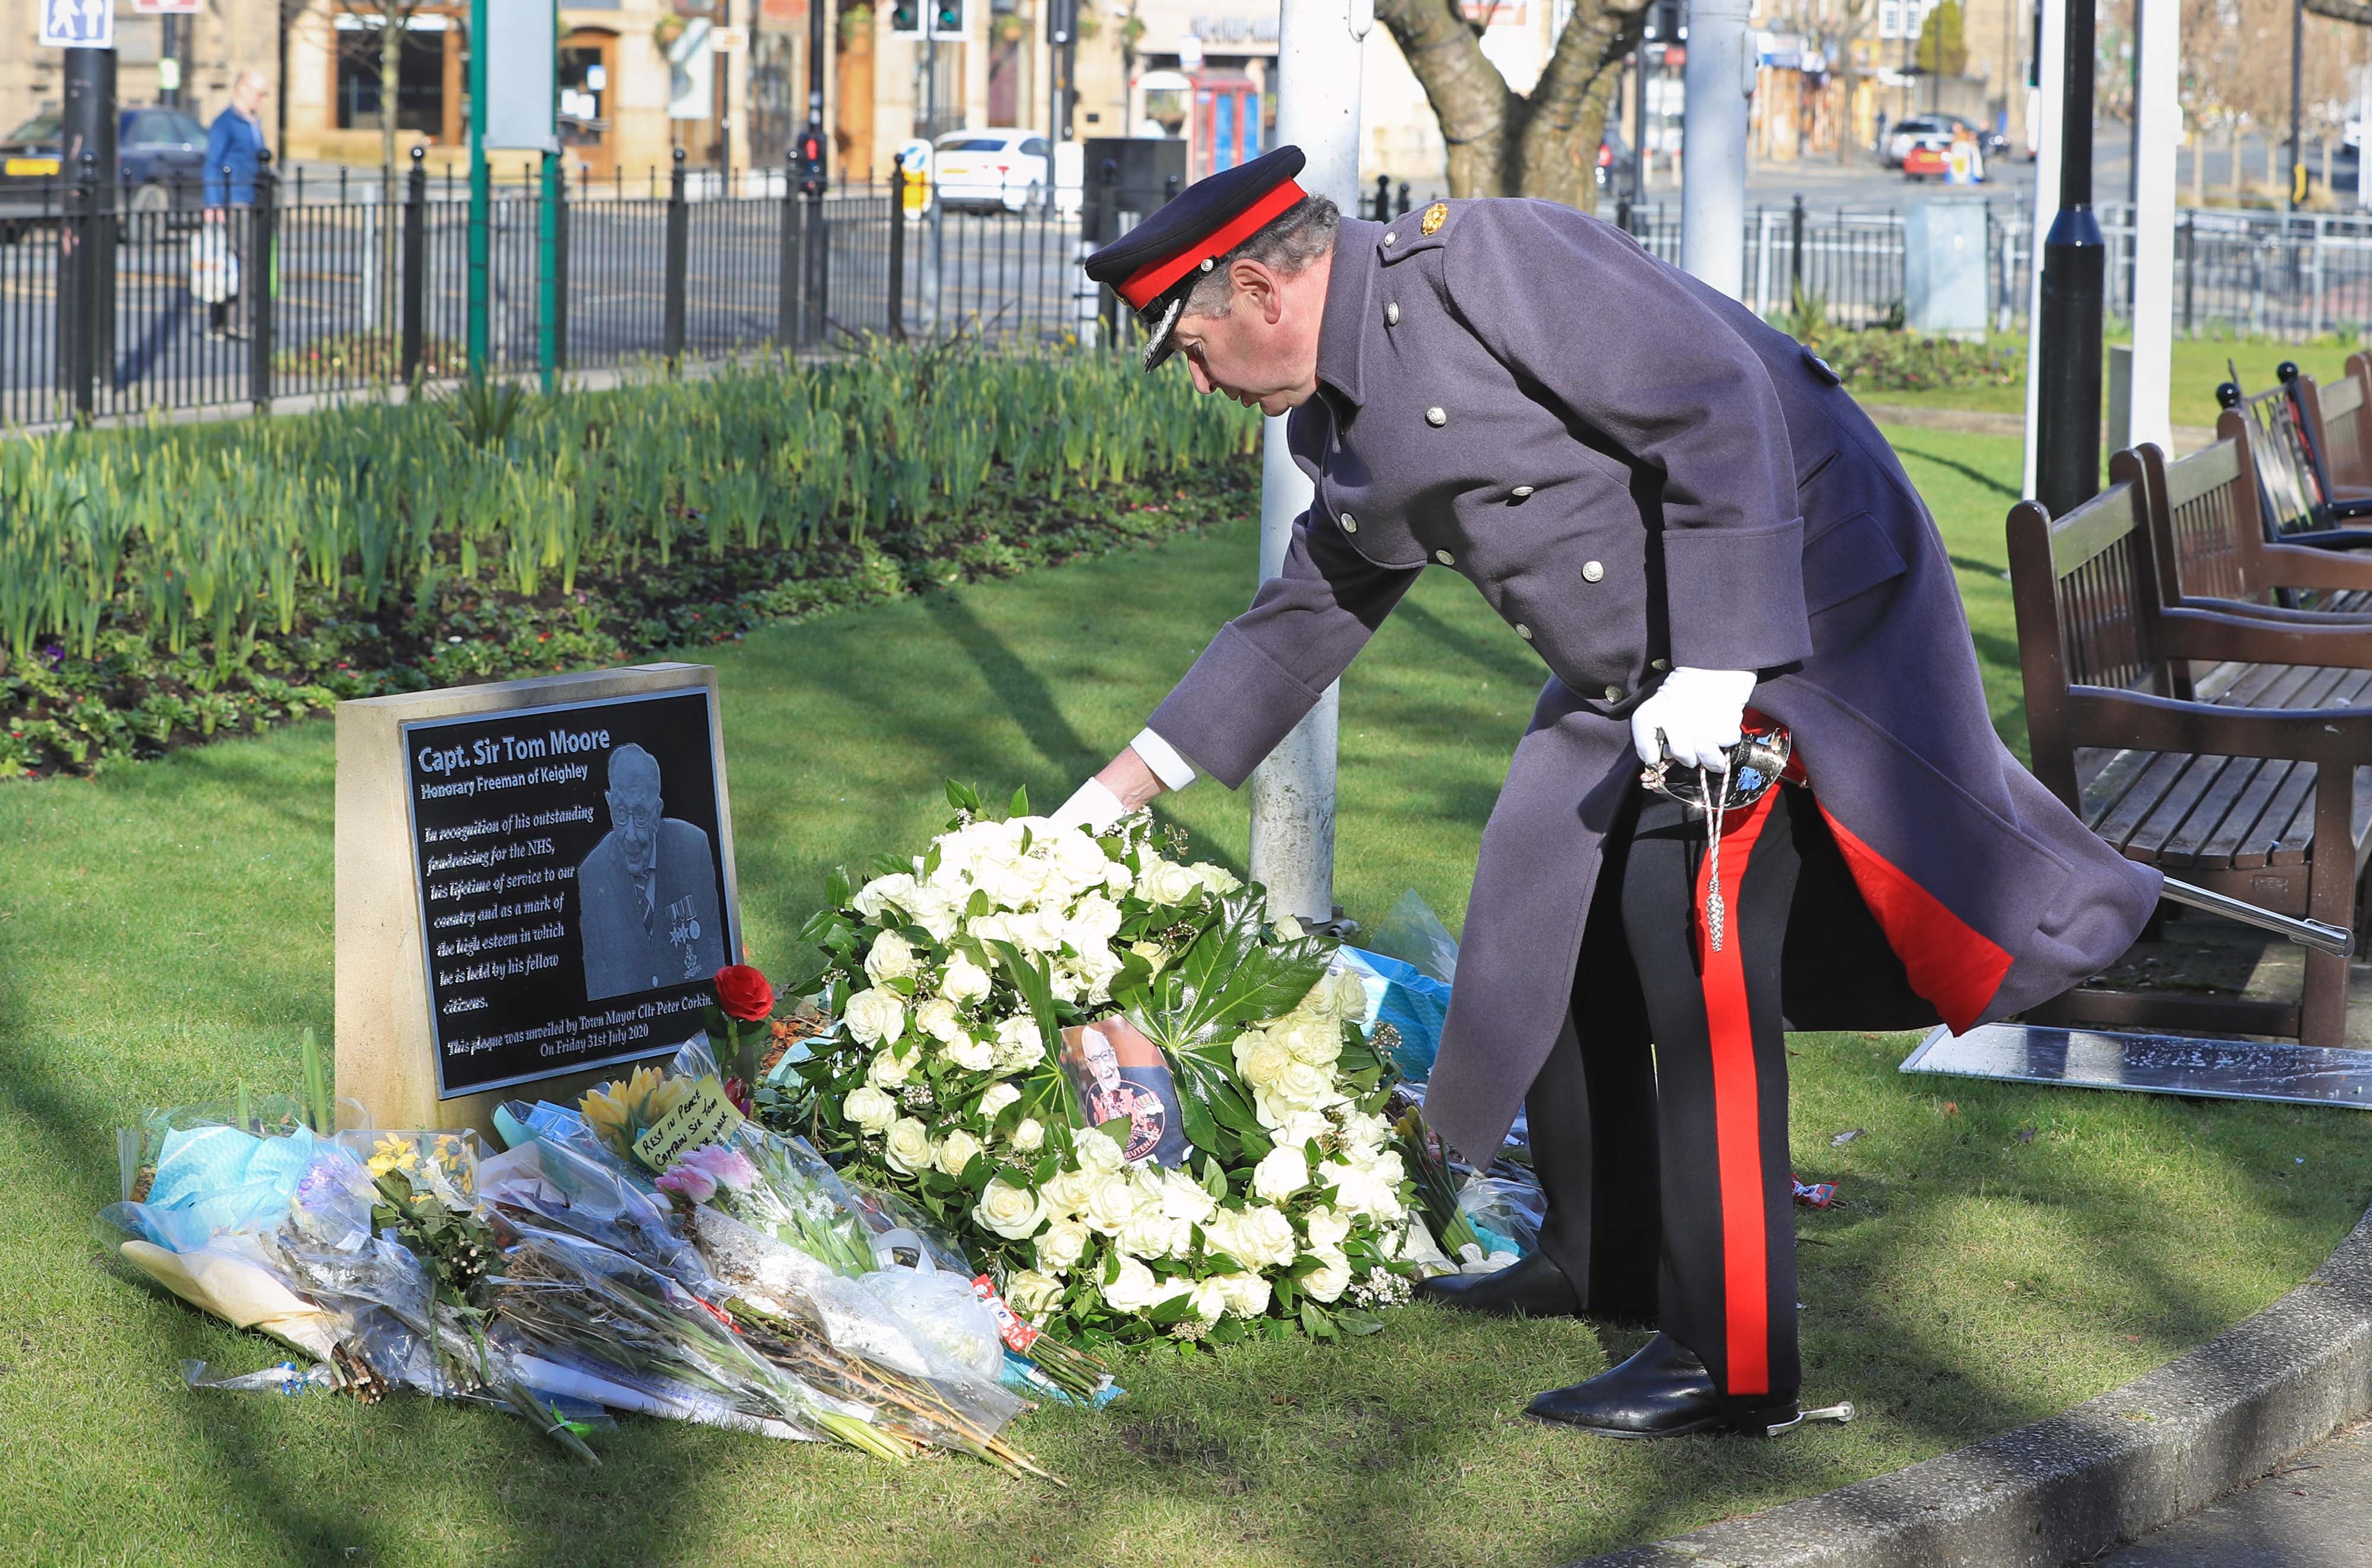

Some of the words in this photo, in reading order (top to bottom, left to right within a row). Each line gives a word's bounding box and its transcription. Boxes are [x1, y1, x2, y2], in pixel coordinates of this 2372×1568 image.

[418, 745, 471, 776] Capt.
[473, 737, 500, 765] Sir
[502, 735, 546, 761] Tom
[549, 729, 610, 755] Moore
[420, 781, 474, 800] Honorary
[477, 772, 525, 791] Freeman
[528, 769, 539, 784] of
[541, 762, 588, 784] Keighley
[425, 828, 438, 842] In
[439, 819, 499, 842] recognition
[502, 815, 514, 835] of
[514, 813, 531, 829] his
[533, 804, 594, 826] outstanding
[426, 851, 489, 877] fundraising
[490, 845, 506, 867] for
[509, 843, 525, 858] the
[527, 838, 555, 856] NHS,
[429, 883, 448, 901] his
[449, 879, 491, 901] lifetime
[493, 873, 505, 894] of
[507, 869, 541, 889] service
[544, 867, 554, 882] to
[557, 866, 575, 880] our
[433, 910, 476, 928] country
[477, 902, 498, 921] and
[501, 905, 512, 917] as
[515, 903, 521, 915] a
[523, 895, 551, 913] mark
[553, 891, 565, 912] of
[436, 940, 455, 957] the
[455, 935, 480, 957] high
[482, 932, 518, 950] esteem
[520, 927, 531, 943] in
[533, 920, 565, 940] which
[439, 970, 454, 986] he
[455, 967, 466, 983] is
[466, 962, 490, 981] held
[492, 960, 506, 980] by
[508, 956, 524, 974] his
[525, 952, 559, 976] fellow
[443, 996, 489, 1015] citizens.
[447, 1039, 470, 1056] This
[470, 1035, 503, 1056] plaque
[504, 1031, 524, 1045] was
[525, 1020, 565, 1041] unveiled
[565, 1018, 578, 1036] by
[578, 1015, 604, 1030] Town
[604, 1011, 636, 1026] Mayor
[637, 1002, 655, 1019] Cllr
[655, 1000, 680, 1015] Peter
[681, 992, 713, 1011] Corkin.
[540, 1043, 554, 1056] On
[556, 1037, 586, 1053] Friday
[588, 1032, 607, 1048] 31st
[607, 1028, 627, 1047] July
[629, 1023, 649, 1040] 2020
[642, 1128, 664, 1155] REST
[667, 1117, 675, 1131] IN
[678, 1089, 702, 1120] PEACE
